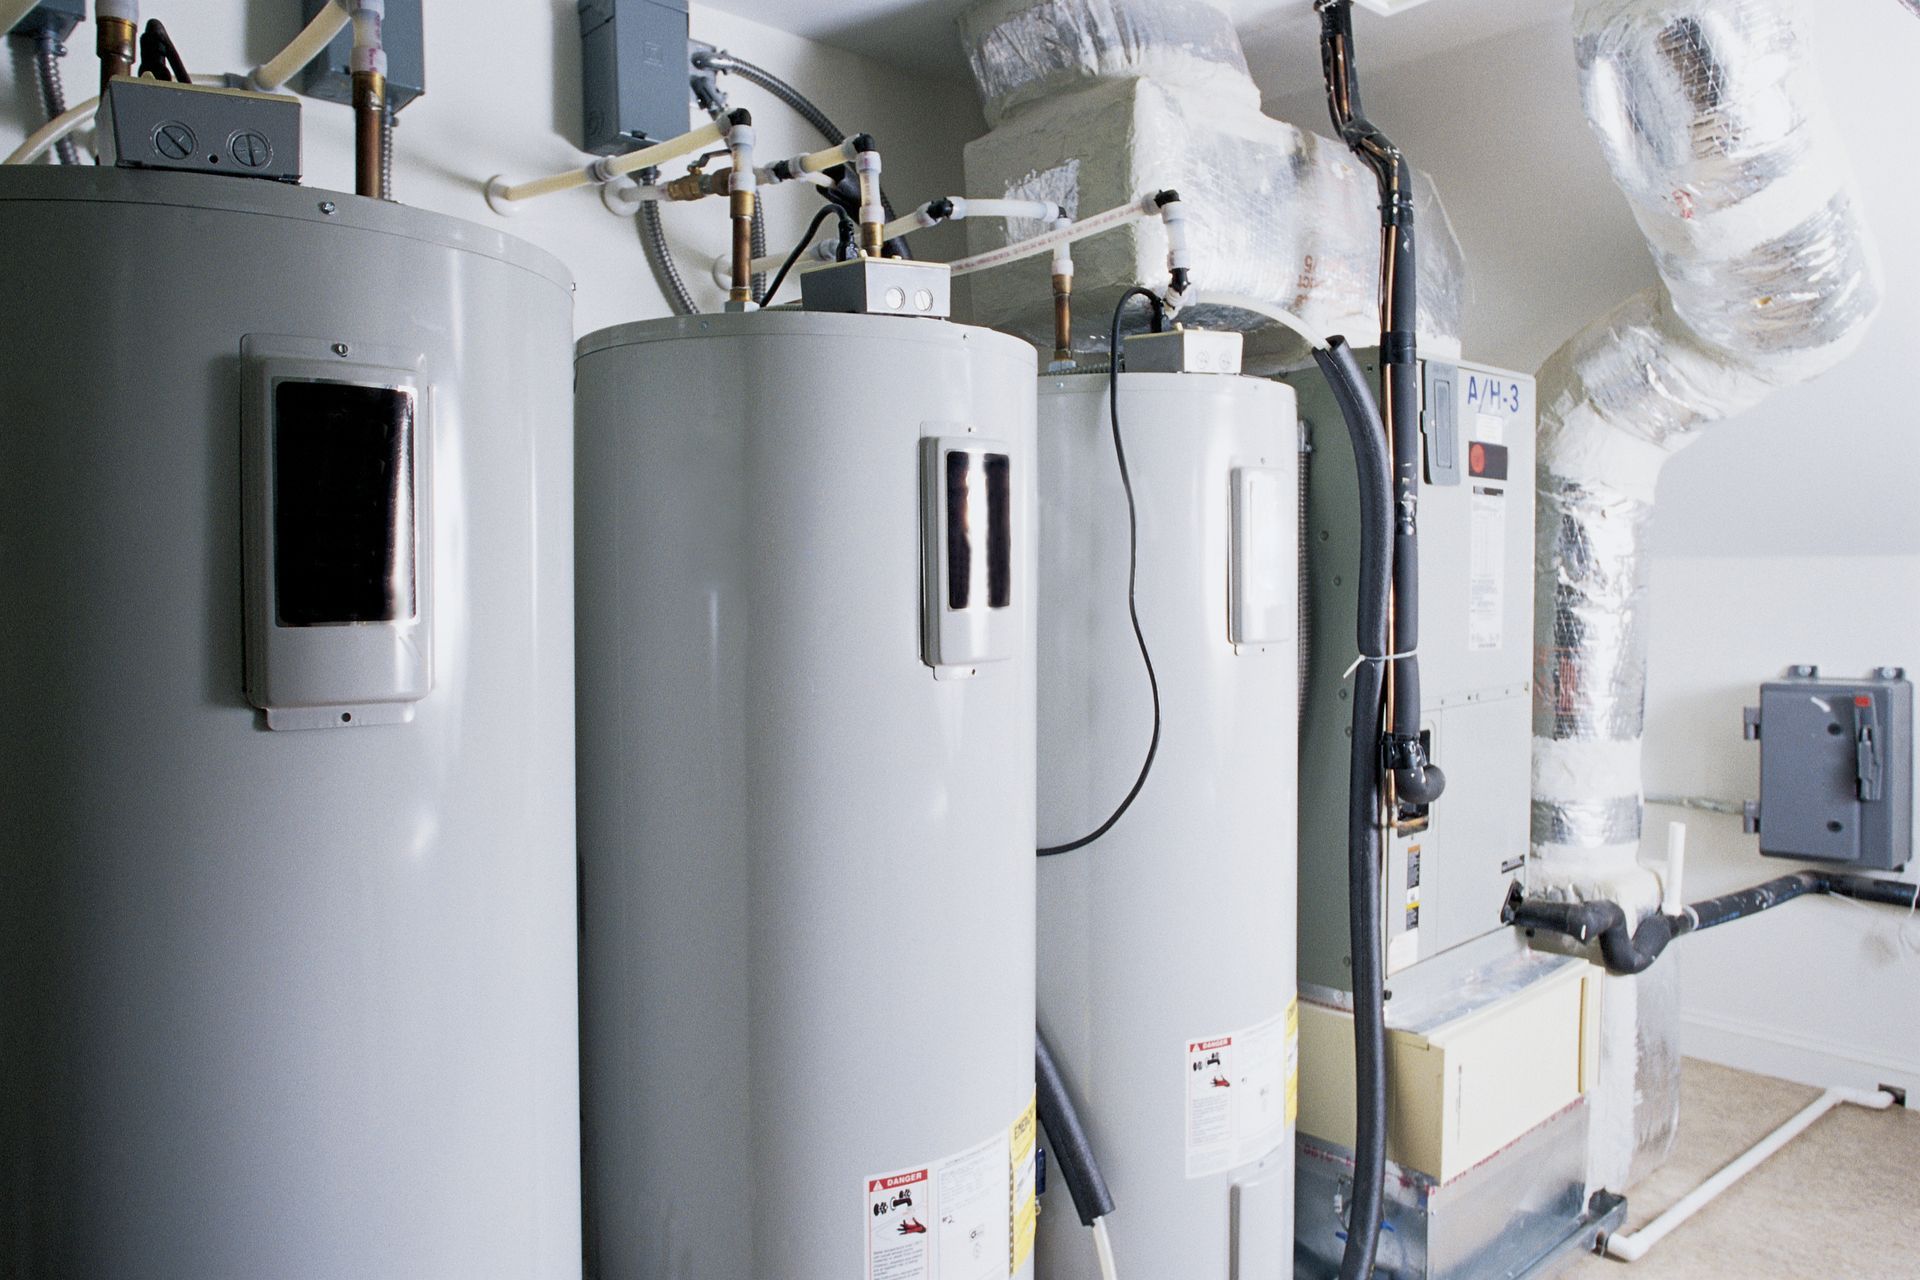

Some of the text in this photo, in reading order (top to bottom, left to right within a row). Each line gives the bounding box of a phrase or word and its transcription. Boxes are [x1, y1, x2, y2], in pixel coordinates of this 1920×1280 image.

[1467, 375, 1519, 413] A/H-3
[1202, 1036, 1228, 1049] DANGER
[886, 1172, 923, 1187] DANGER
